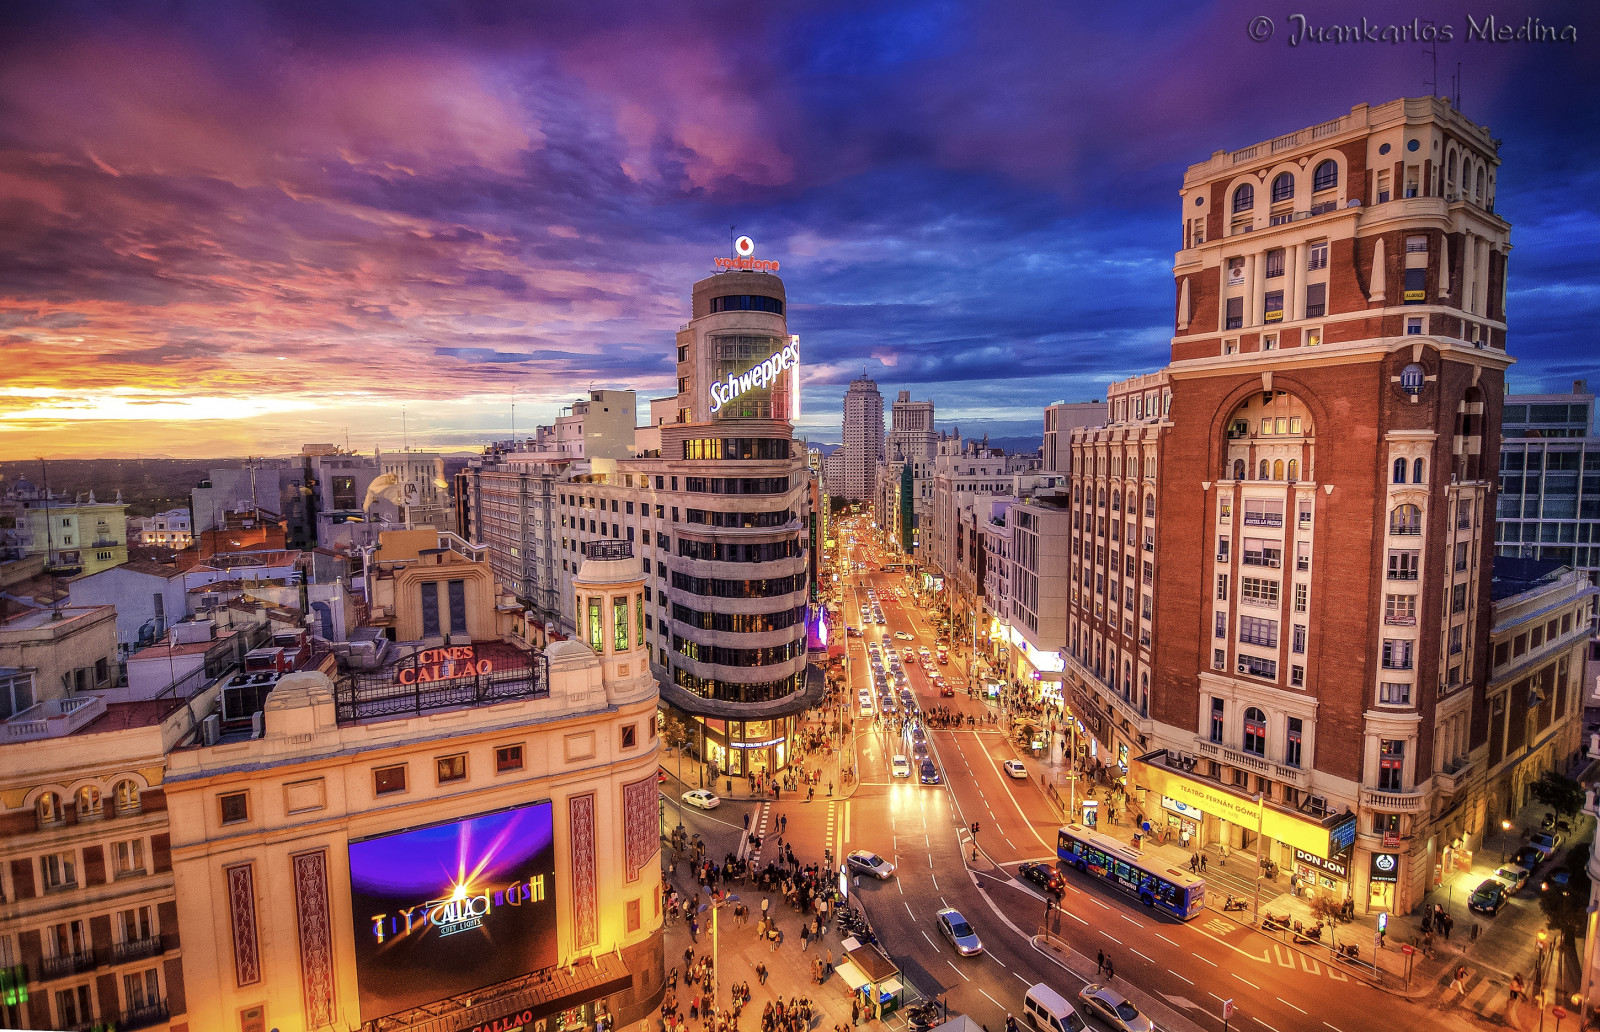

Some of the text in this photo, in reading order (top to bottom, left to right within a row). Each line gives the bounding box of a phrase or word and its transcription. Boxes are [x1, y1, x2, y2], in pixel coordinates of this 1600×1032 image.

[714, 255, 780, 271] vodafone
[709, 339, 799, 413] Schweppes
[419, 646, 474, 664] CINES
[399, 659, 493, 685] CALLAO
[1180, 784, 1205, 798] TEATRO
[1205, 794, 1234, 809] FERNÁN
[1296, 849, 1321, 866] DON
[1322, 860, 1345, 875] JON
[426, 895, 491, 925] CALLAO
